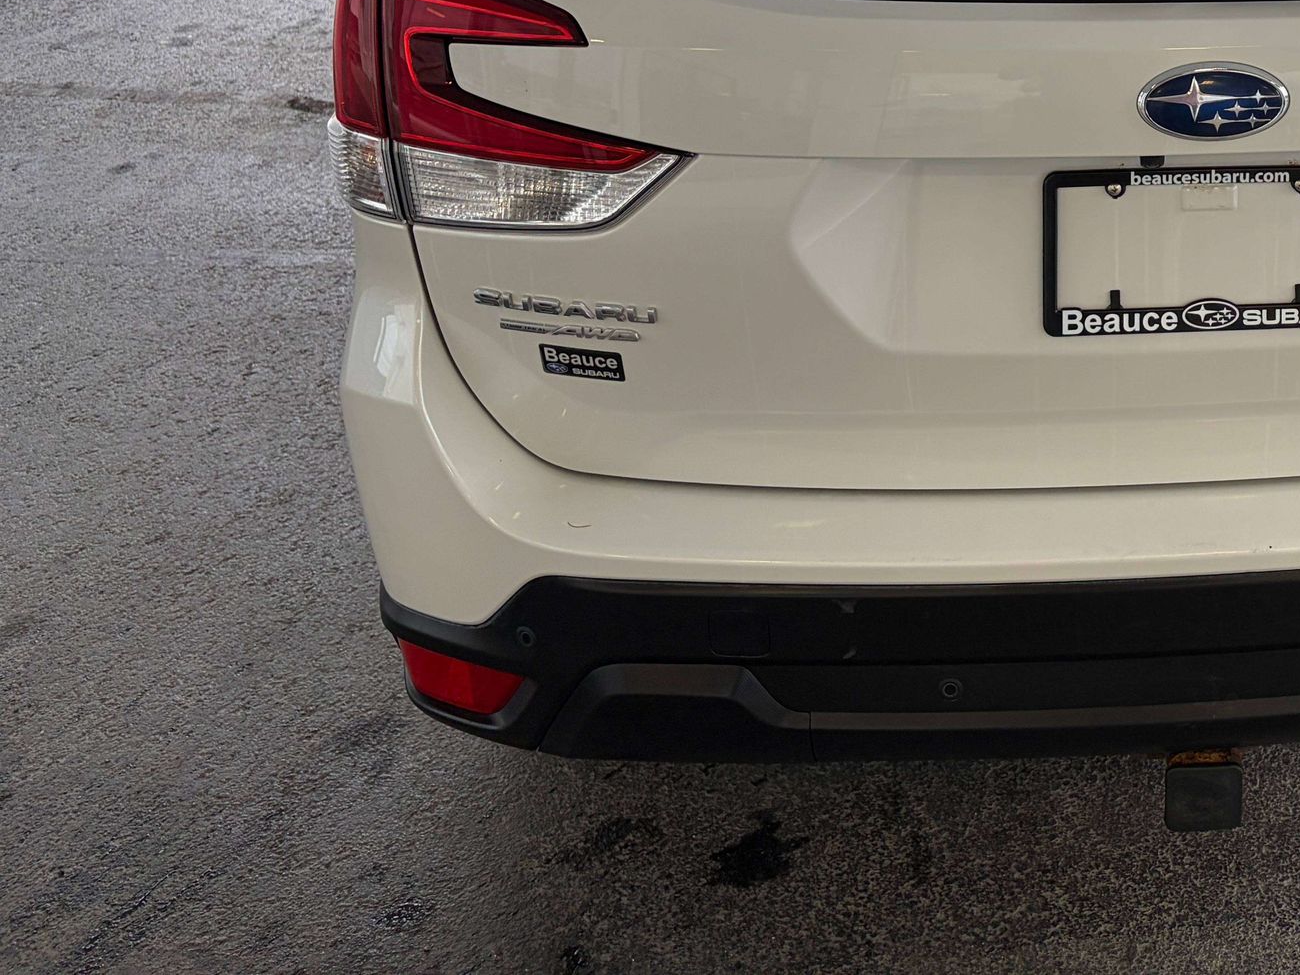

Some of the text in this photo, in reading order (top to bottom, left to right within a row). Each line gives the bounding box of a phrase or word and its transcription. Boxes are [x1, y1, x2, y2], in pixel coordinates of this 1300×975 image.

[1130, 169, 1290, 186] beaucesubaru.com
[473, 286, 659, 324] SUBARU
[1061, 309, 1178, 336] Beauce
[552, 325, 642, 342] AWD
[543, 346, 619, 369] Beauce
[571, 367, 621, 379] SUBARU
